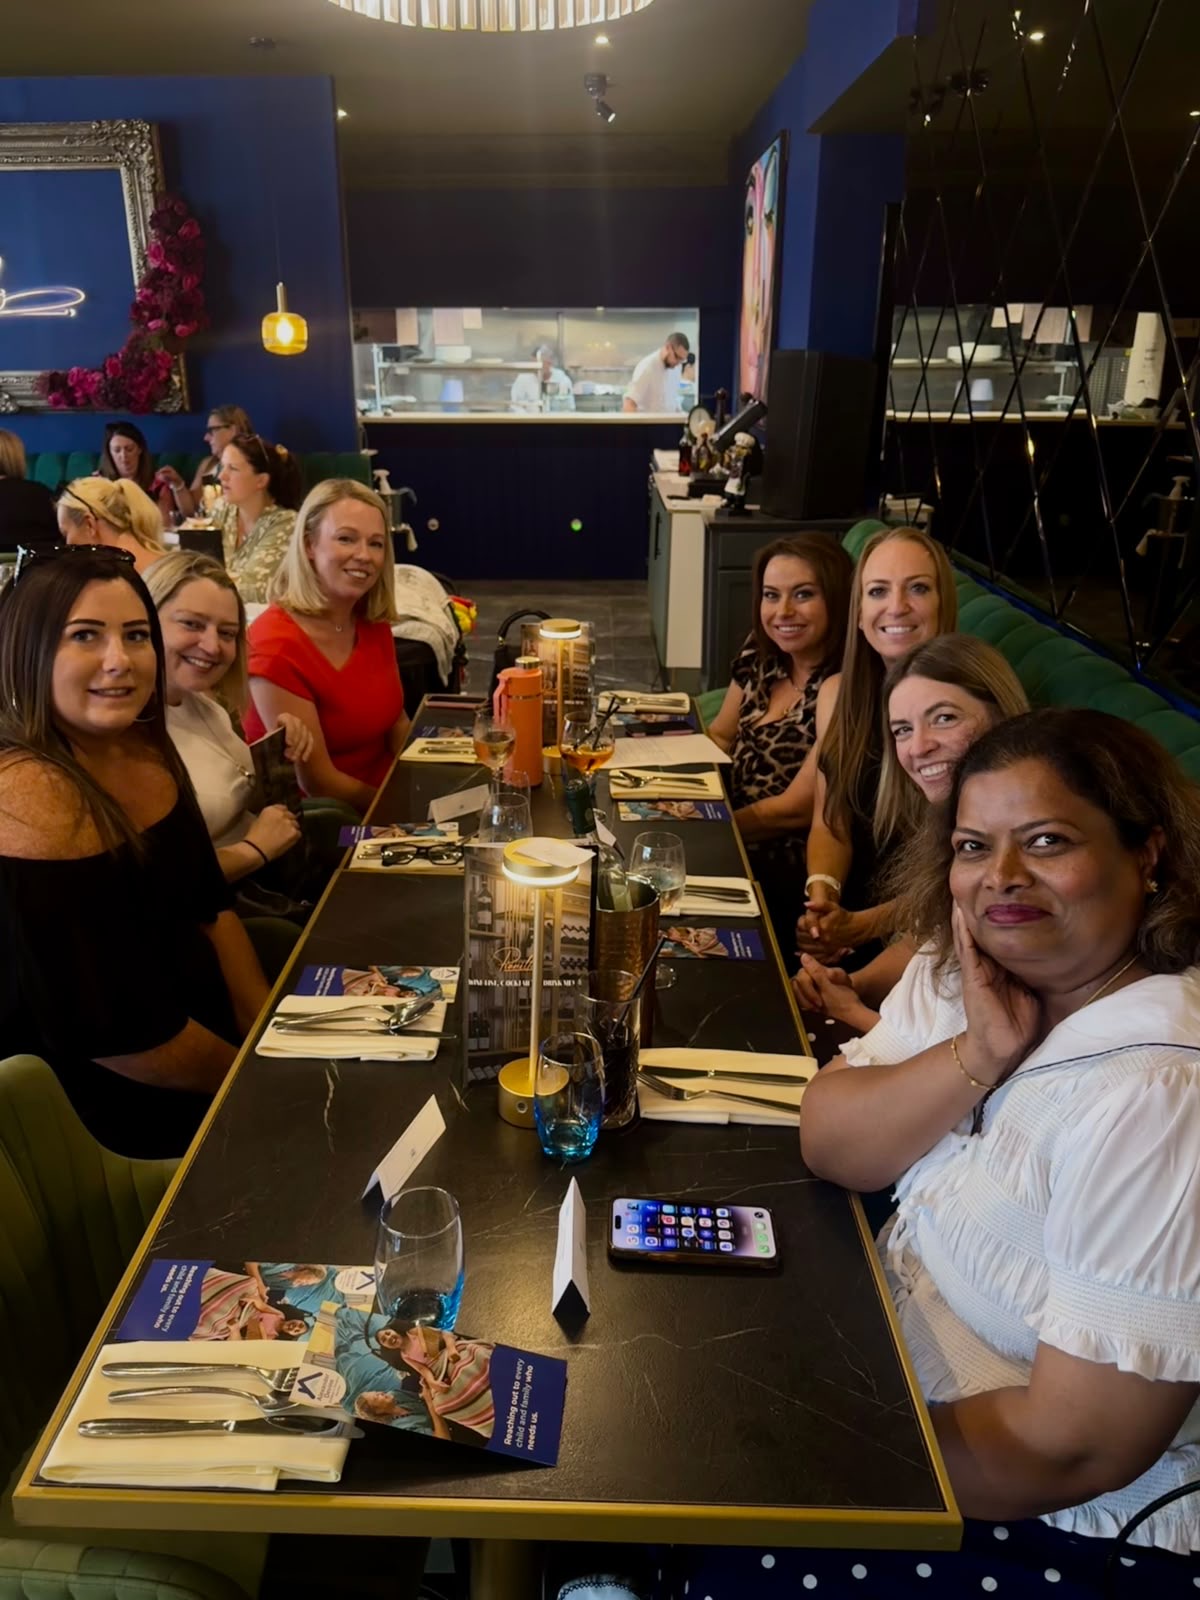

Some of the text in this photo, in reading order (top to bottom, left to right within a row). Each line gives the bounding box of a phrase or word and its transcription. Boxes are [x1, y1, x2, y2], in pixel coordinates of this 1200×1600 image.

[543, 979, 562, 987] DRINK
[170, 1280, 180, 1293] and
[175, 1294, 184, 1306] out
[171, 1306, 180, 1314] to
[153, 1314, 165, 1328] who
[525, 1365, 534, 1382] who
[504, 1358, 525, 1445] Reaching out to every
[520, 1383, 532, 1408] family
[515, 1426, 525, 1448] child
[527, 1424, 537, 1450] needs
